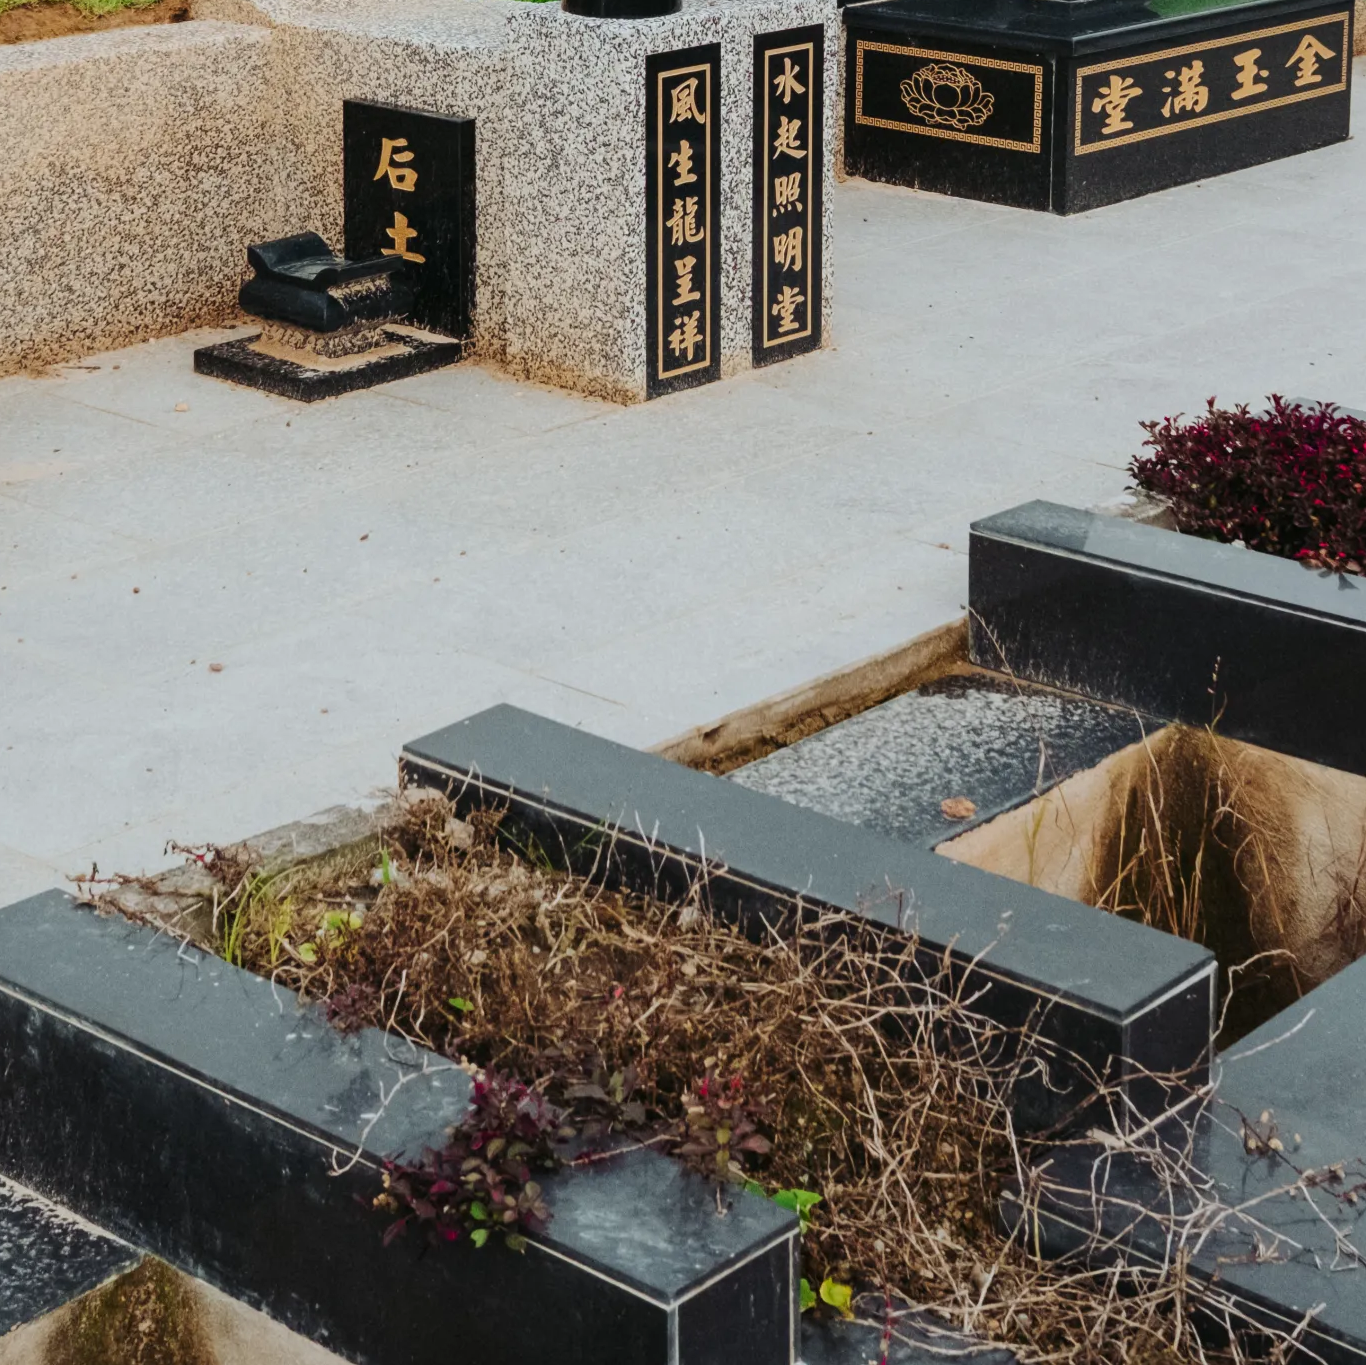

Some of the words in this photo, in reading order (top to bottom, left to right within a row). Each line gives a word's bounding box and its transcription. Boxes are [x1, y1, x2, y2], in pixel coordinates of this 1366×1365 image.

[373, 137, 426, 264] 后土
[666, 77, 706, 362] 風生龍呈祥
[771, 57, 807, 334] 水起照明堂
